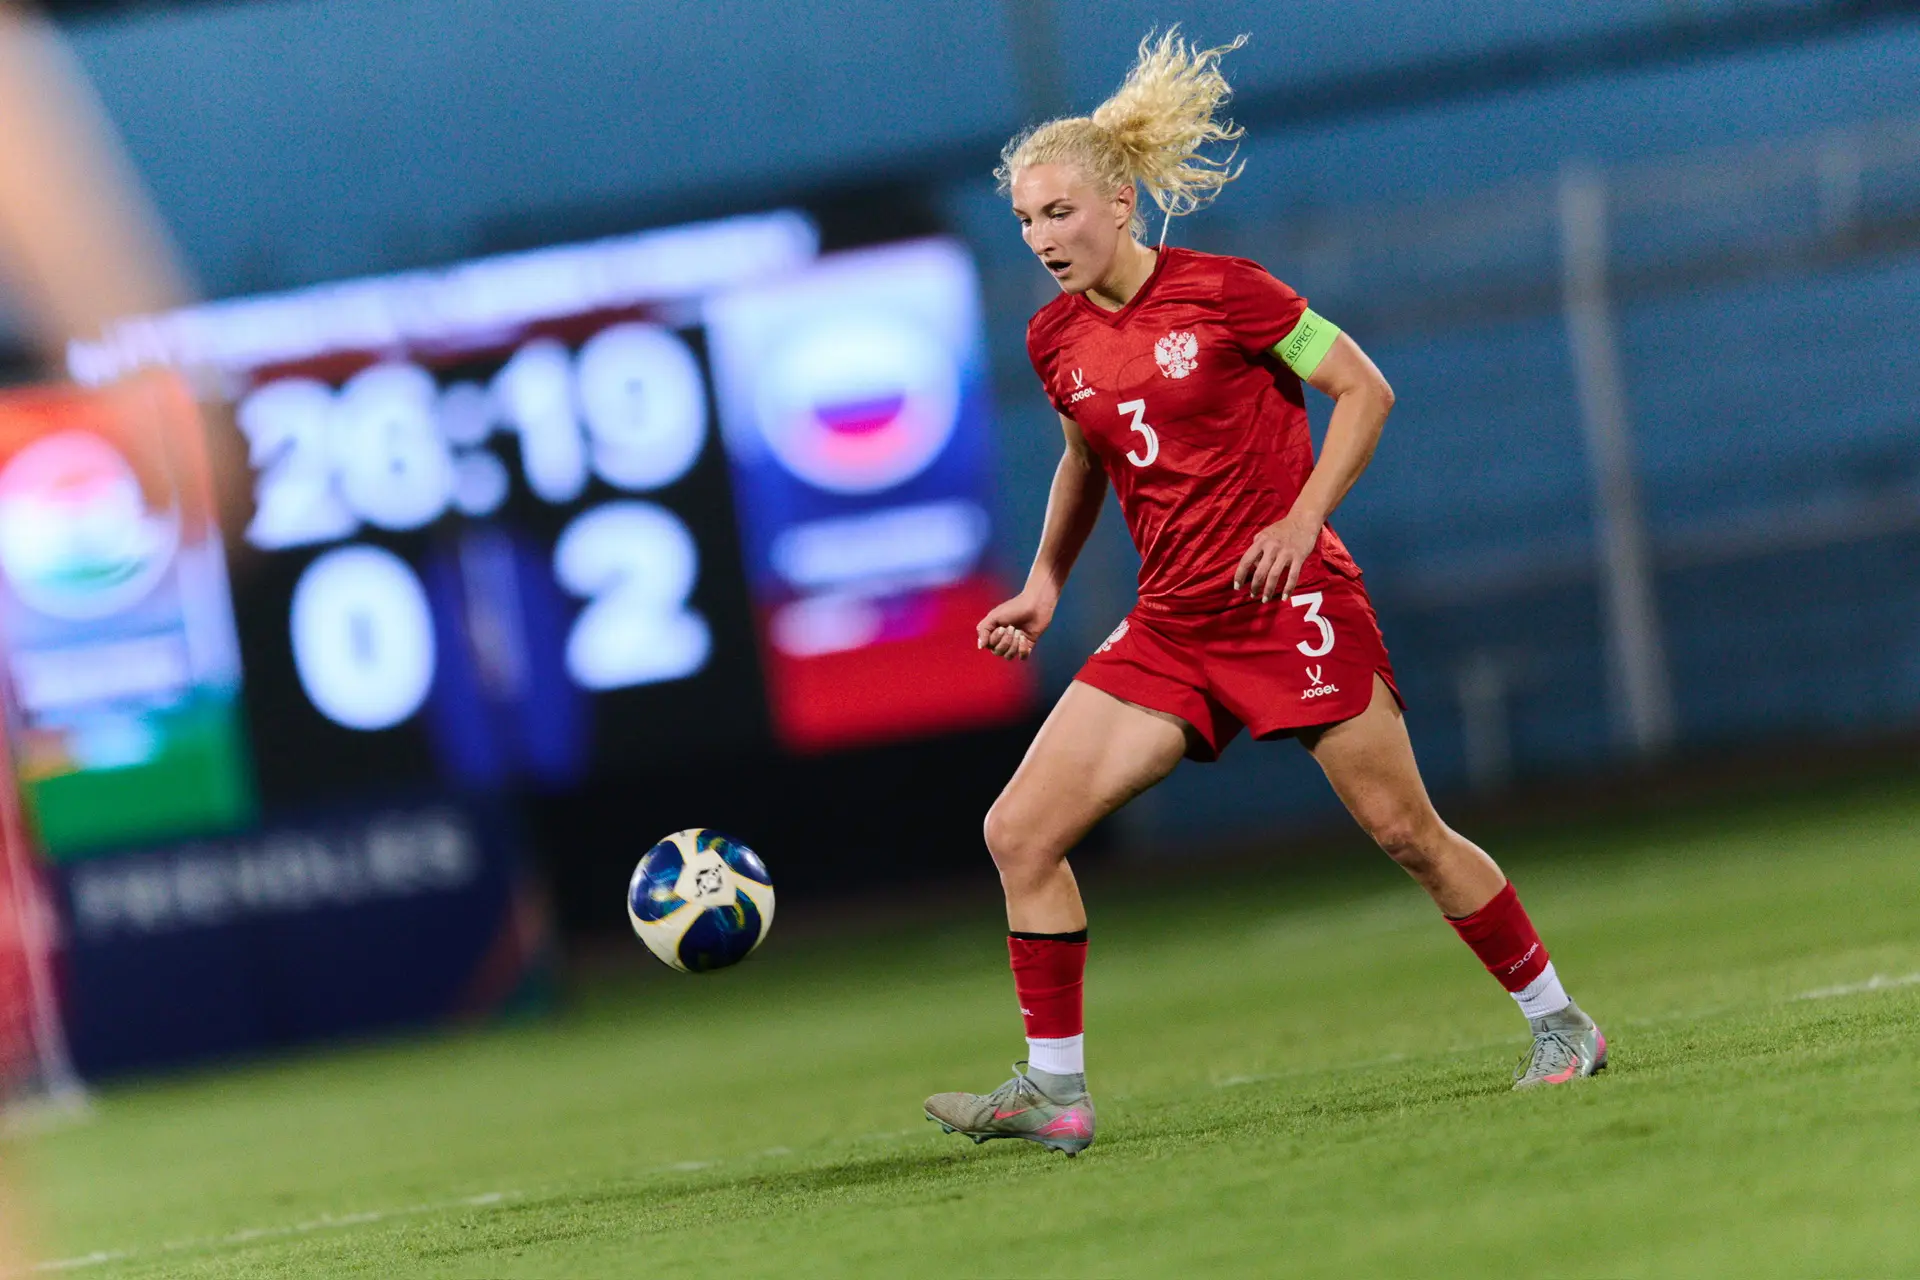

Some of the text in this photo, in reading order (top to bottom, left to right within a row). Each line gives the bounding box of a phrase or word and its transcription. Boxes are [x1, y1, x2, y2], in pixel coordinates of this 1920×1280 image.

[1285, 324, 1314, 361] RESPECT
[1117, 398, 1160, 468] 3
[291, 543, 436, 730] 0
[554, 499, 712, 692] 2
[1290, 591, 1336, 658] 3
